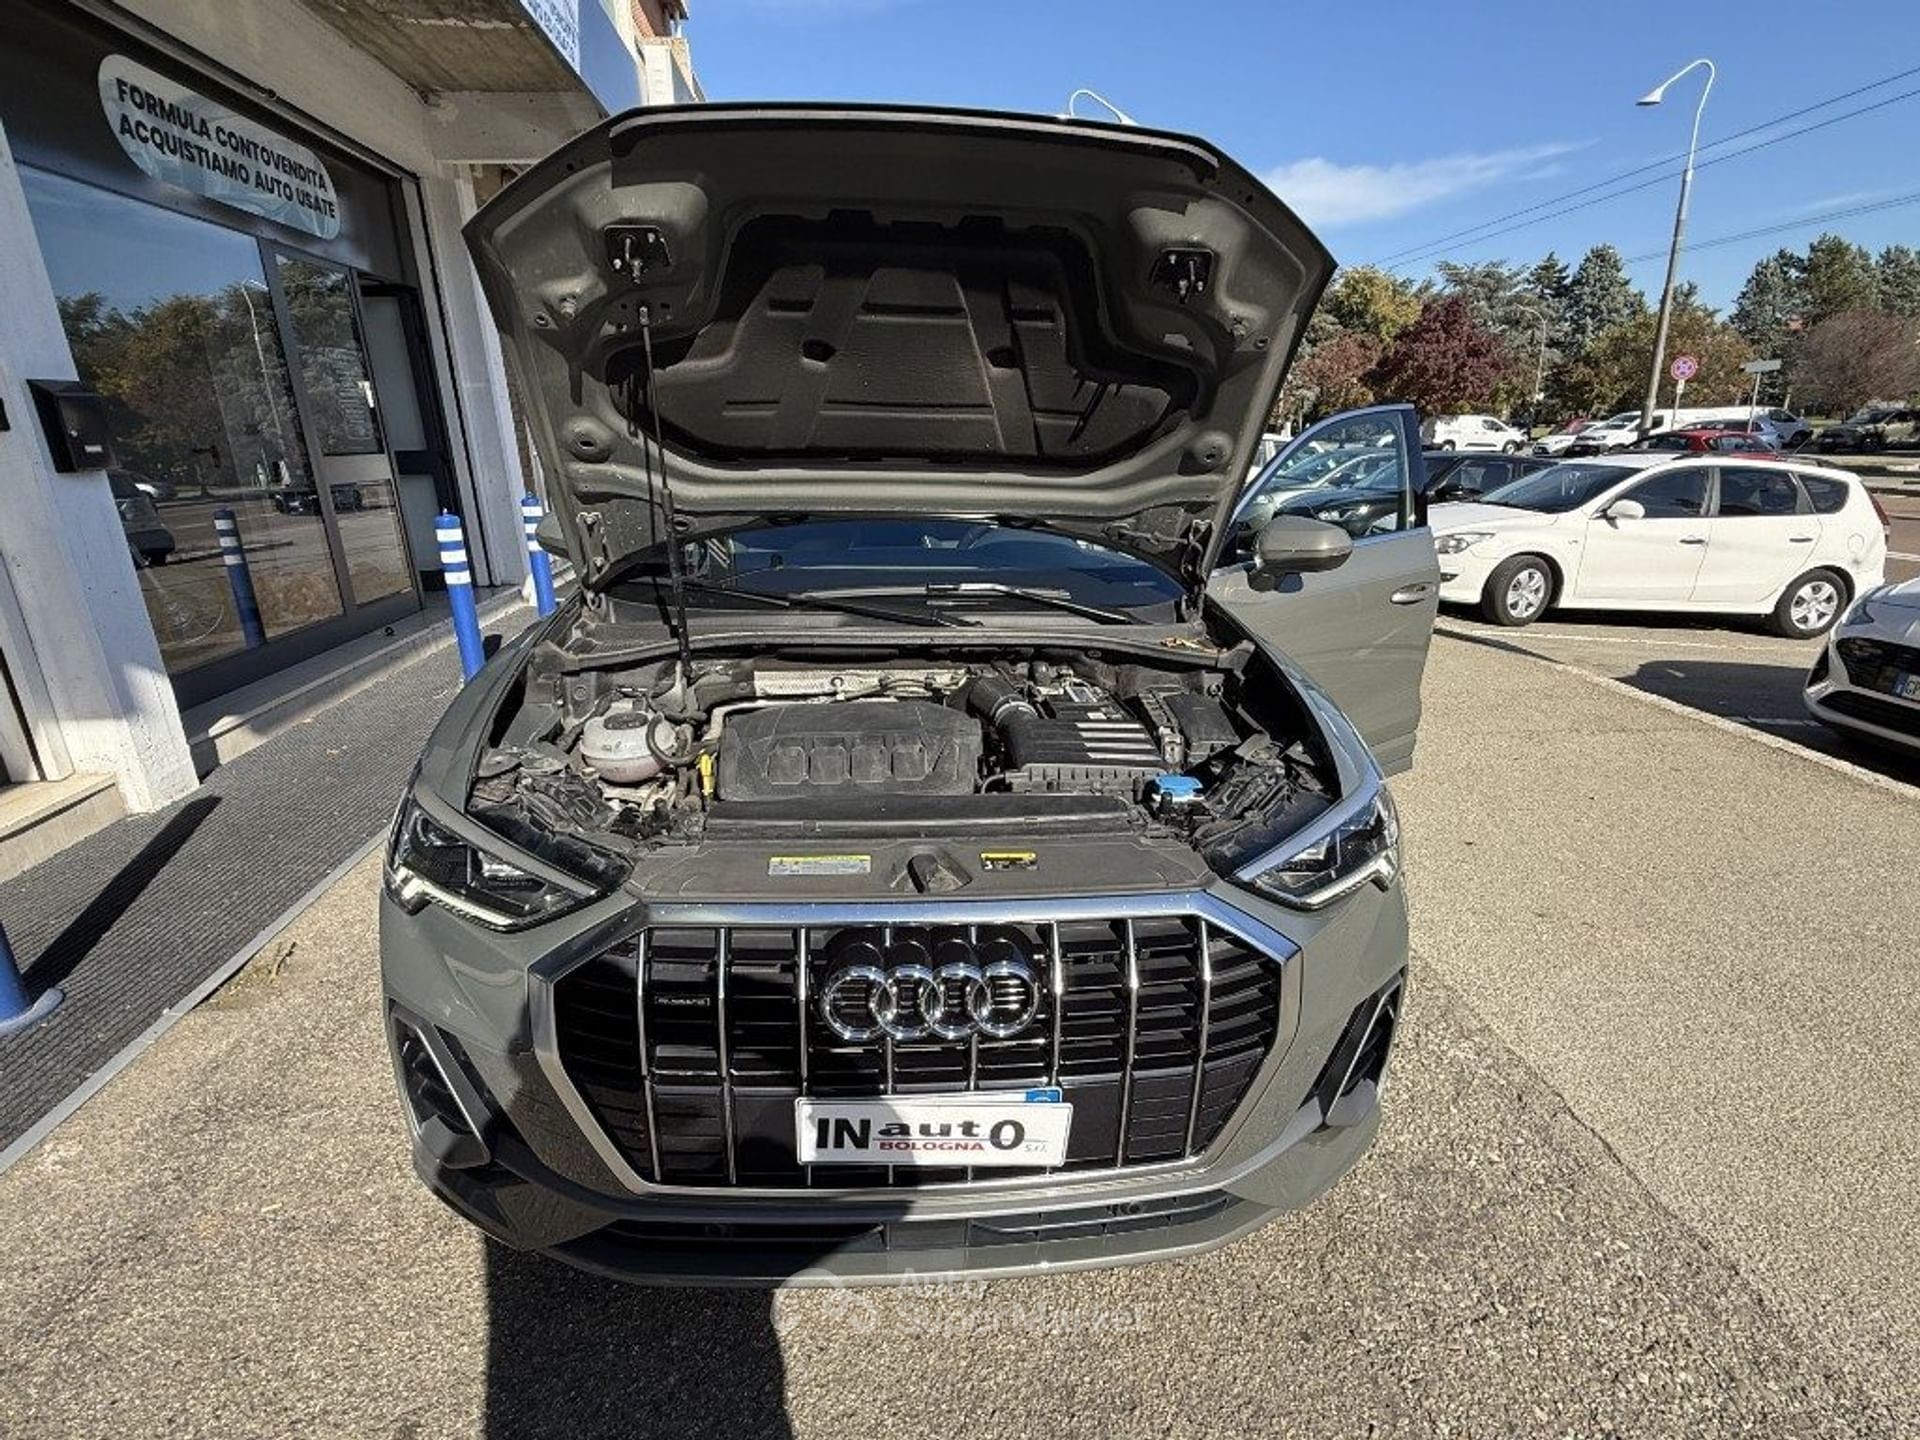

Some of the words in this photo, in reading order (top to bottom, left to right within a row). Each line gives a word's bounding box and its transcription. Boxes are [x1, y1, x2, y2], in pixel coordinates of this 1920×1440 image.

[116, 77, 212, 141] FORMULA
[215, 125, 328, 193] CONTOVENDITA
[119, 113, 251, 185] ACQUISTIAMO
[255, 170, 293, 202] AUTO
[296, 187, 336, 219] USATE
[878, 1140, 986, 1152] BOLOGNA
